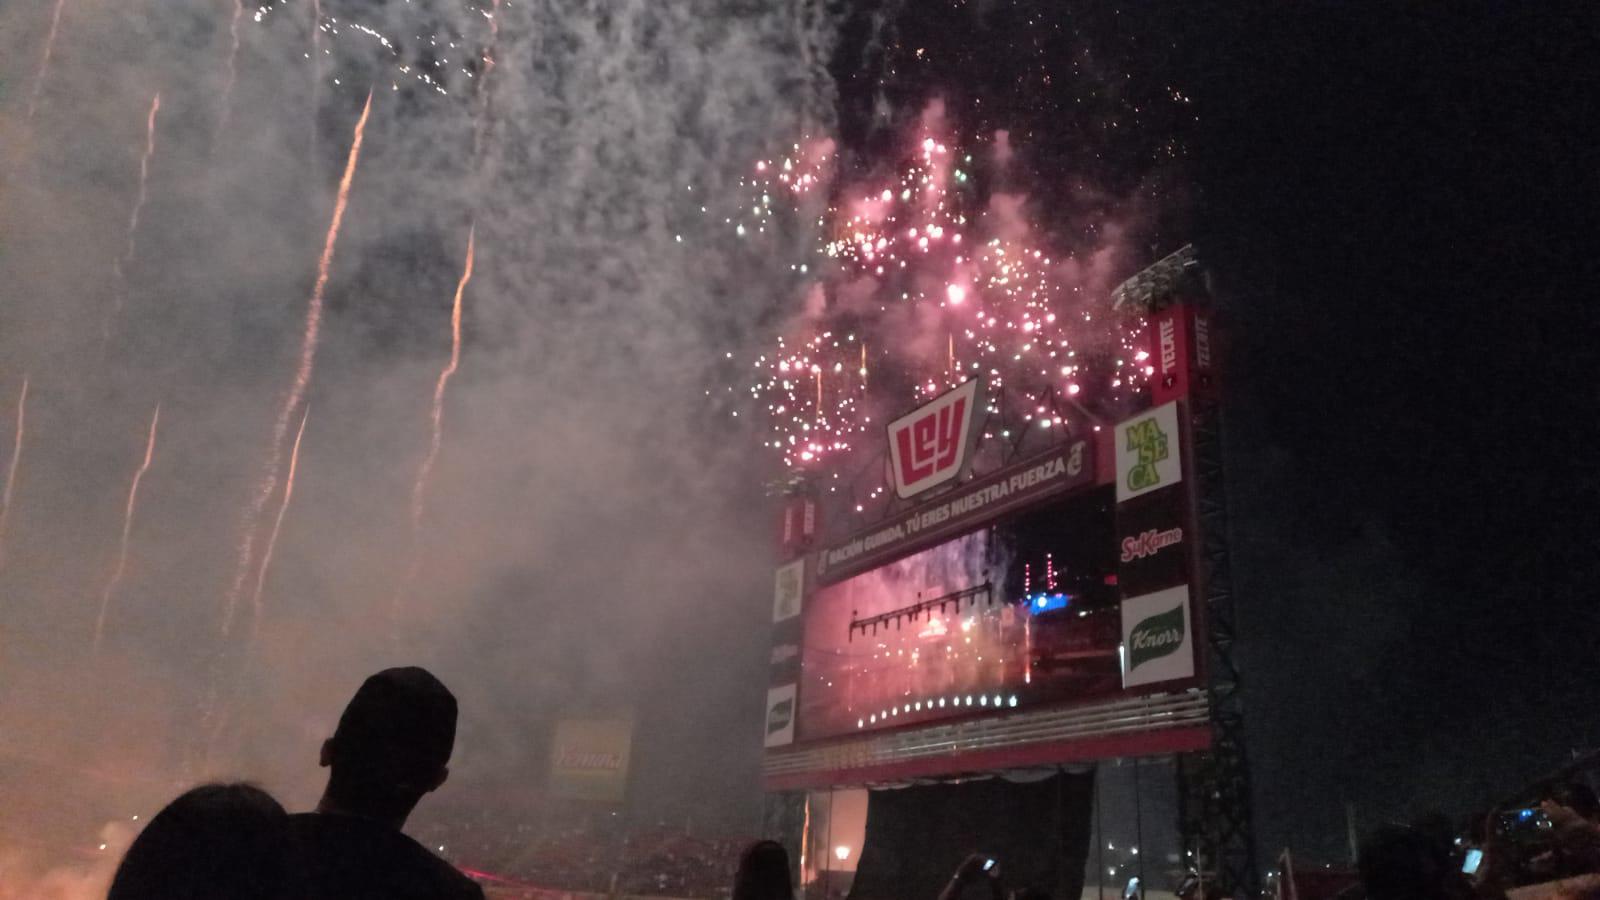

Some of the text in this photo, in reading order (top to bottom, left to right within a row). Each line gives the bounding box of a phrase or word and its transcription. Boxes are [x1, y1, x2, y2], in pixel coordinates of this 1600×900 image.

[1160, 317, 1176, 374] TECATE
[921, 504, 950, 528] ERES
[950, 480, 1009, 517] NUESTRA
[1009, 457, 1066, 493] FUERZA
[1131, 627, 1179, 649] Knorr
